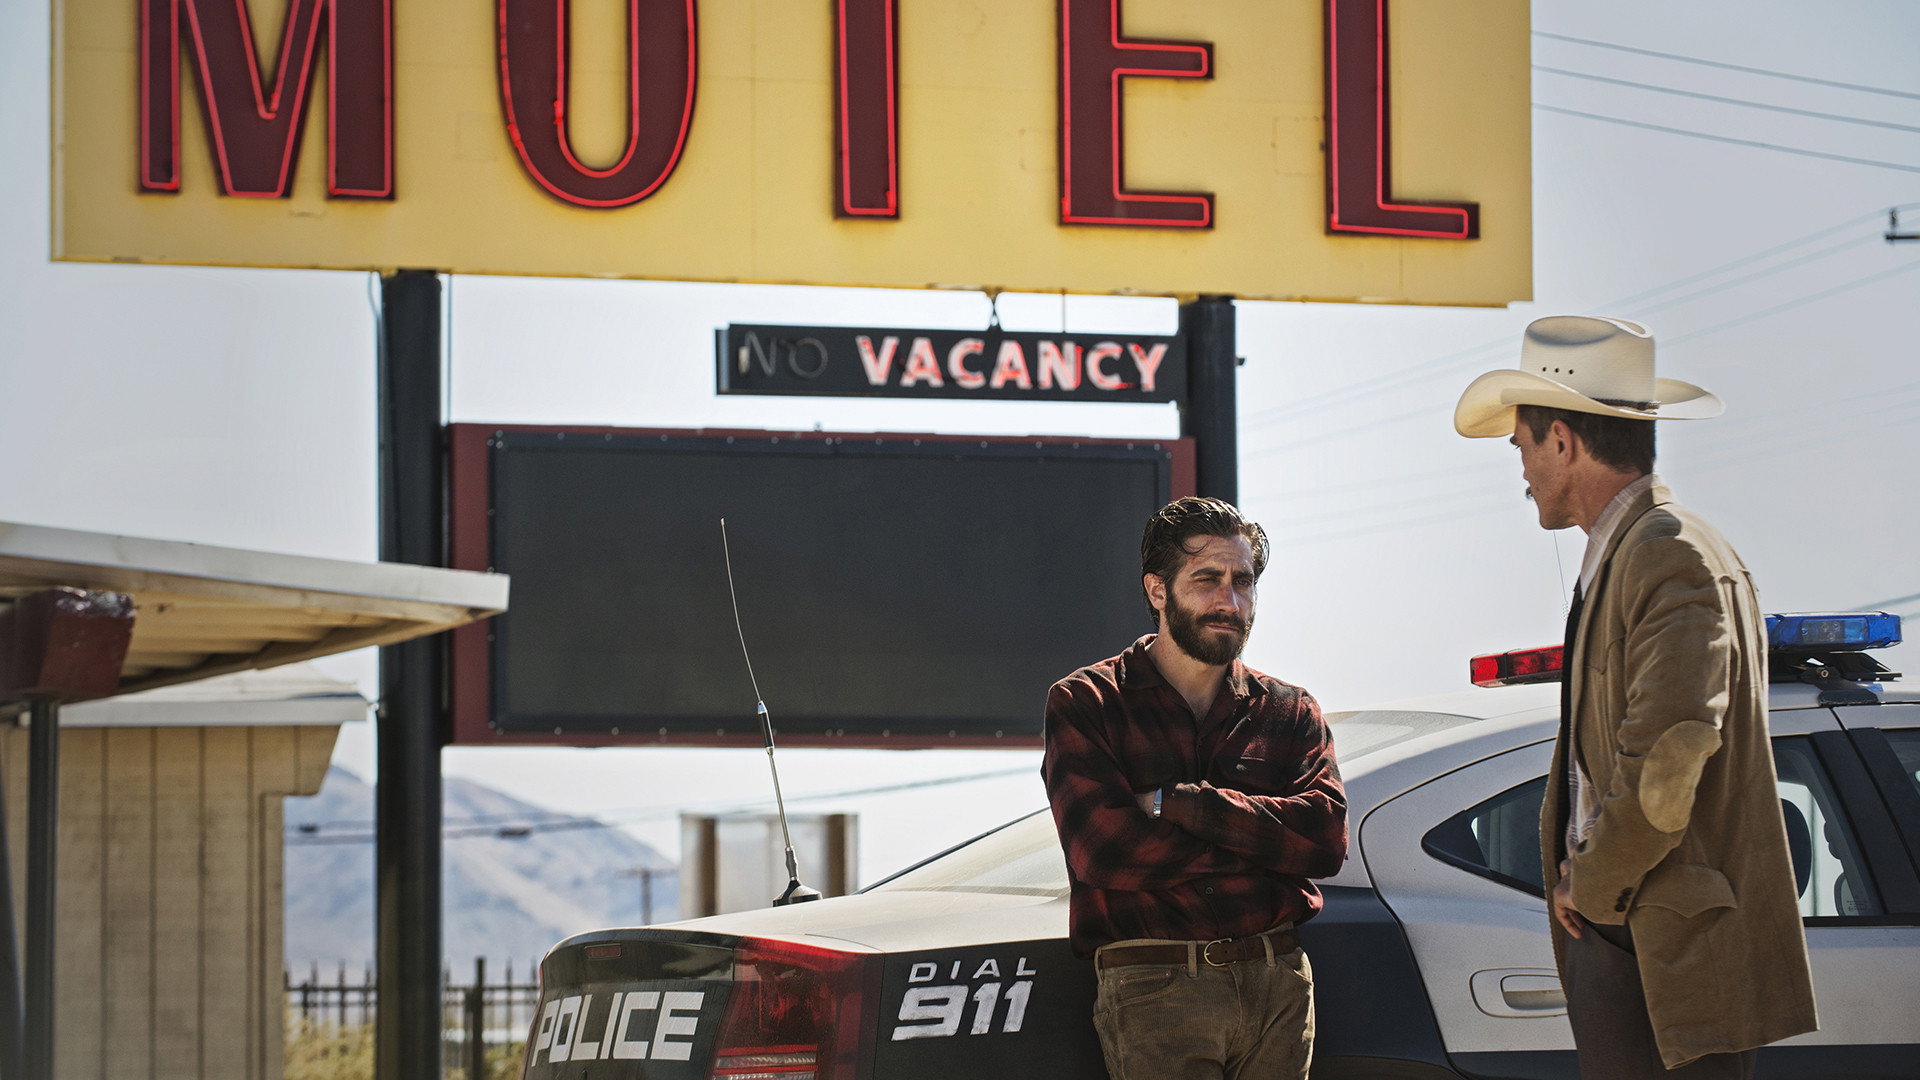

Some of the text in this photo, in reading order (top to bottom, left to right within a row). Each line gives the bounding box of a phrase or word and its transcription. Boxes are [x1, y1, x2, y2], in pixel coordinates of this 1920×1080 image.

[740, 331, 1169, 391] NO VACANCY
[908, 957, 1037, 983] DIAL
[531, 992, 704, 1067] POLICE
[892, 981, 1033, 1041] 911
